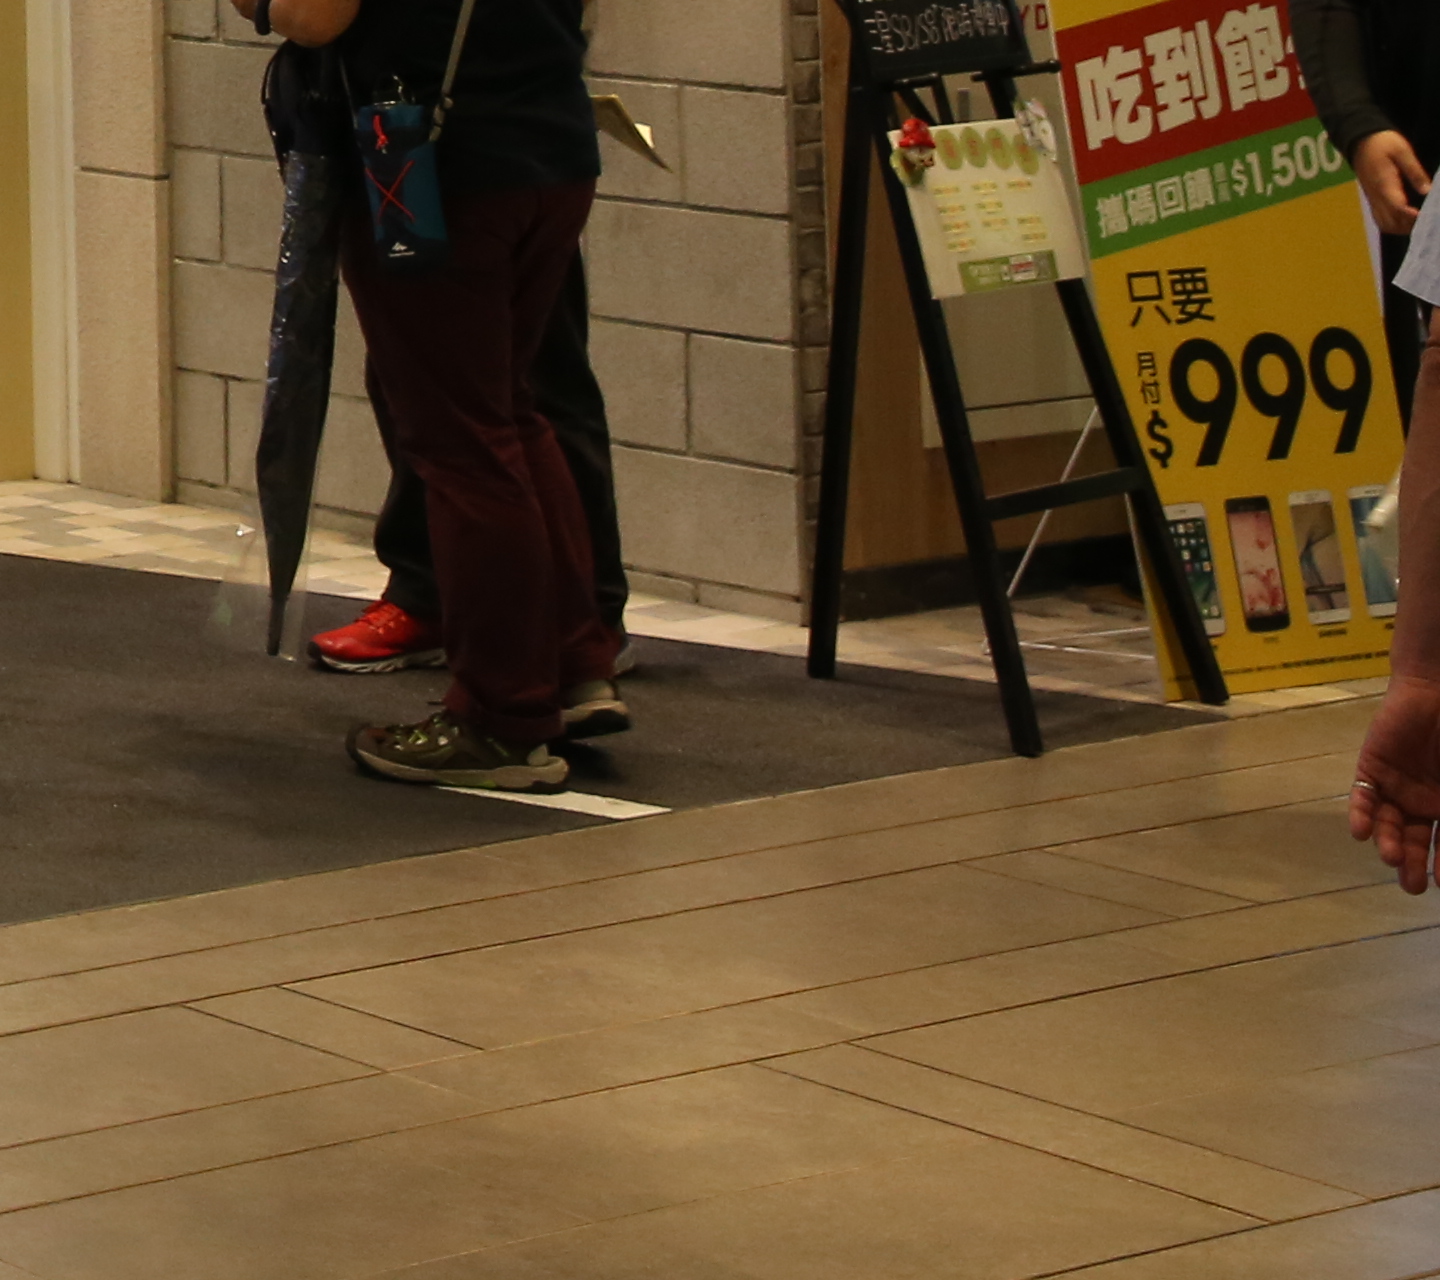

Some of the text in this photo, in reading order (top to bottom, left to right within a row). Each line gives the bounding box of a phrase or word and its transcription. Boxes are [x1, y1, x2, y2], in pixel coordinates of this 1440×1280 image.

[1075, 3, 1307, 151] 吃到飽
[1125, 267, 1216, 327] 只要
[1168, 325, 1372, 467] 999
